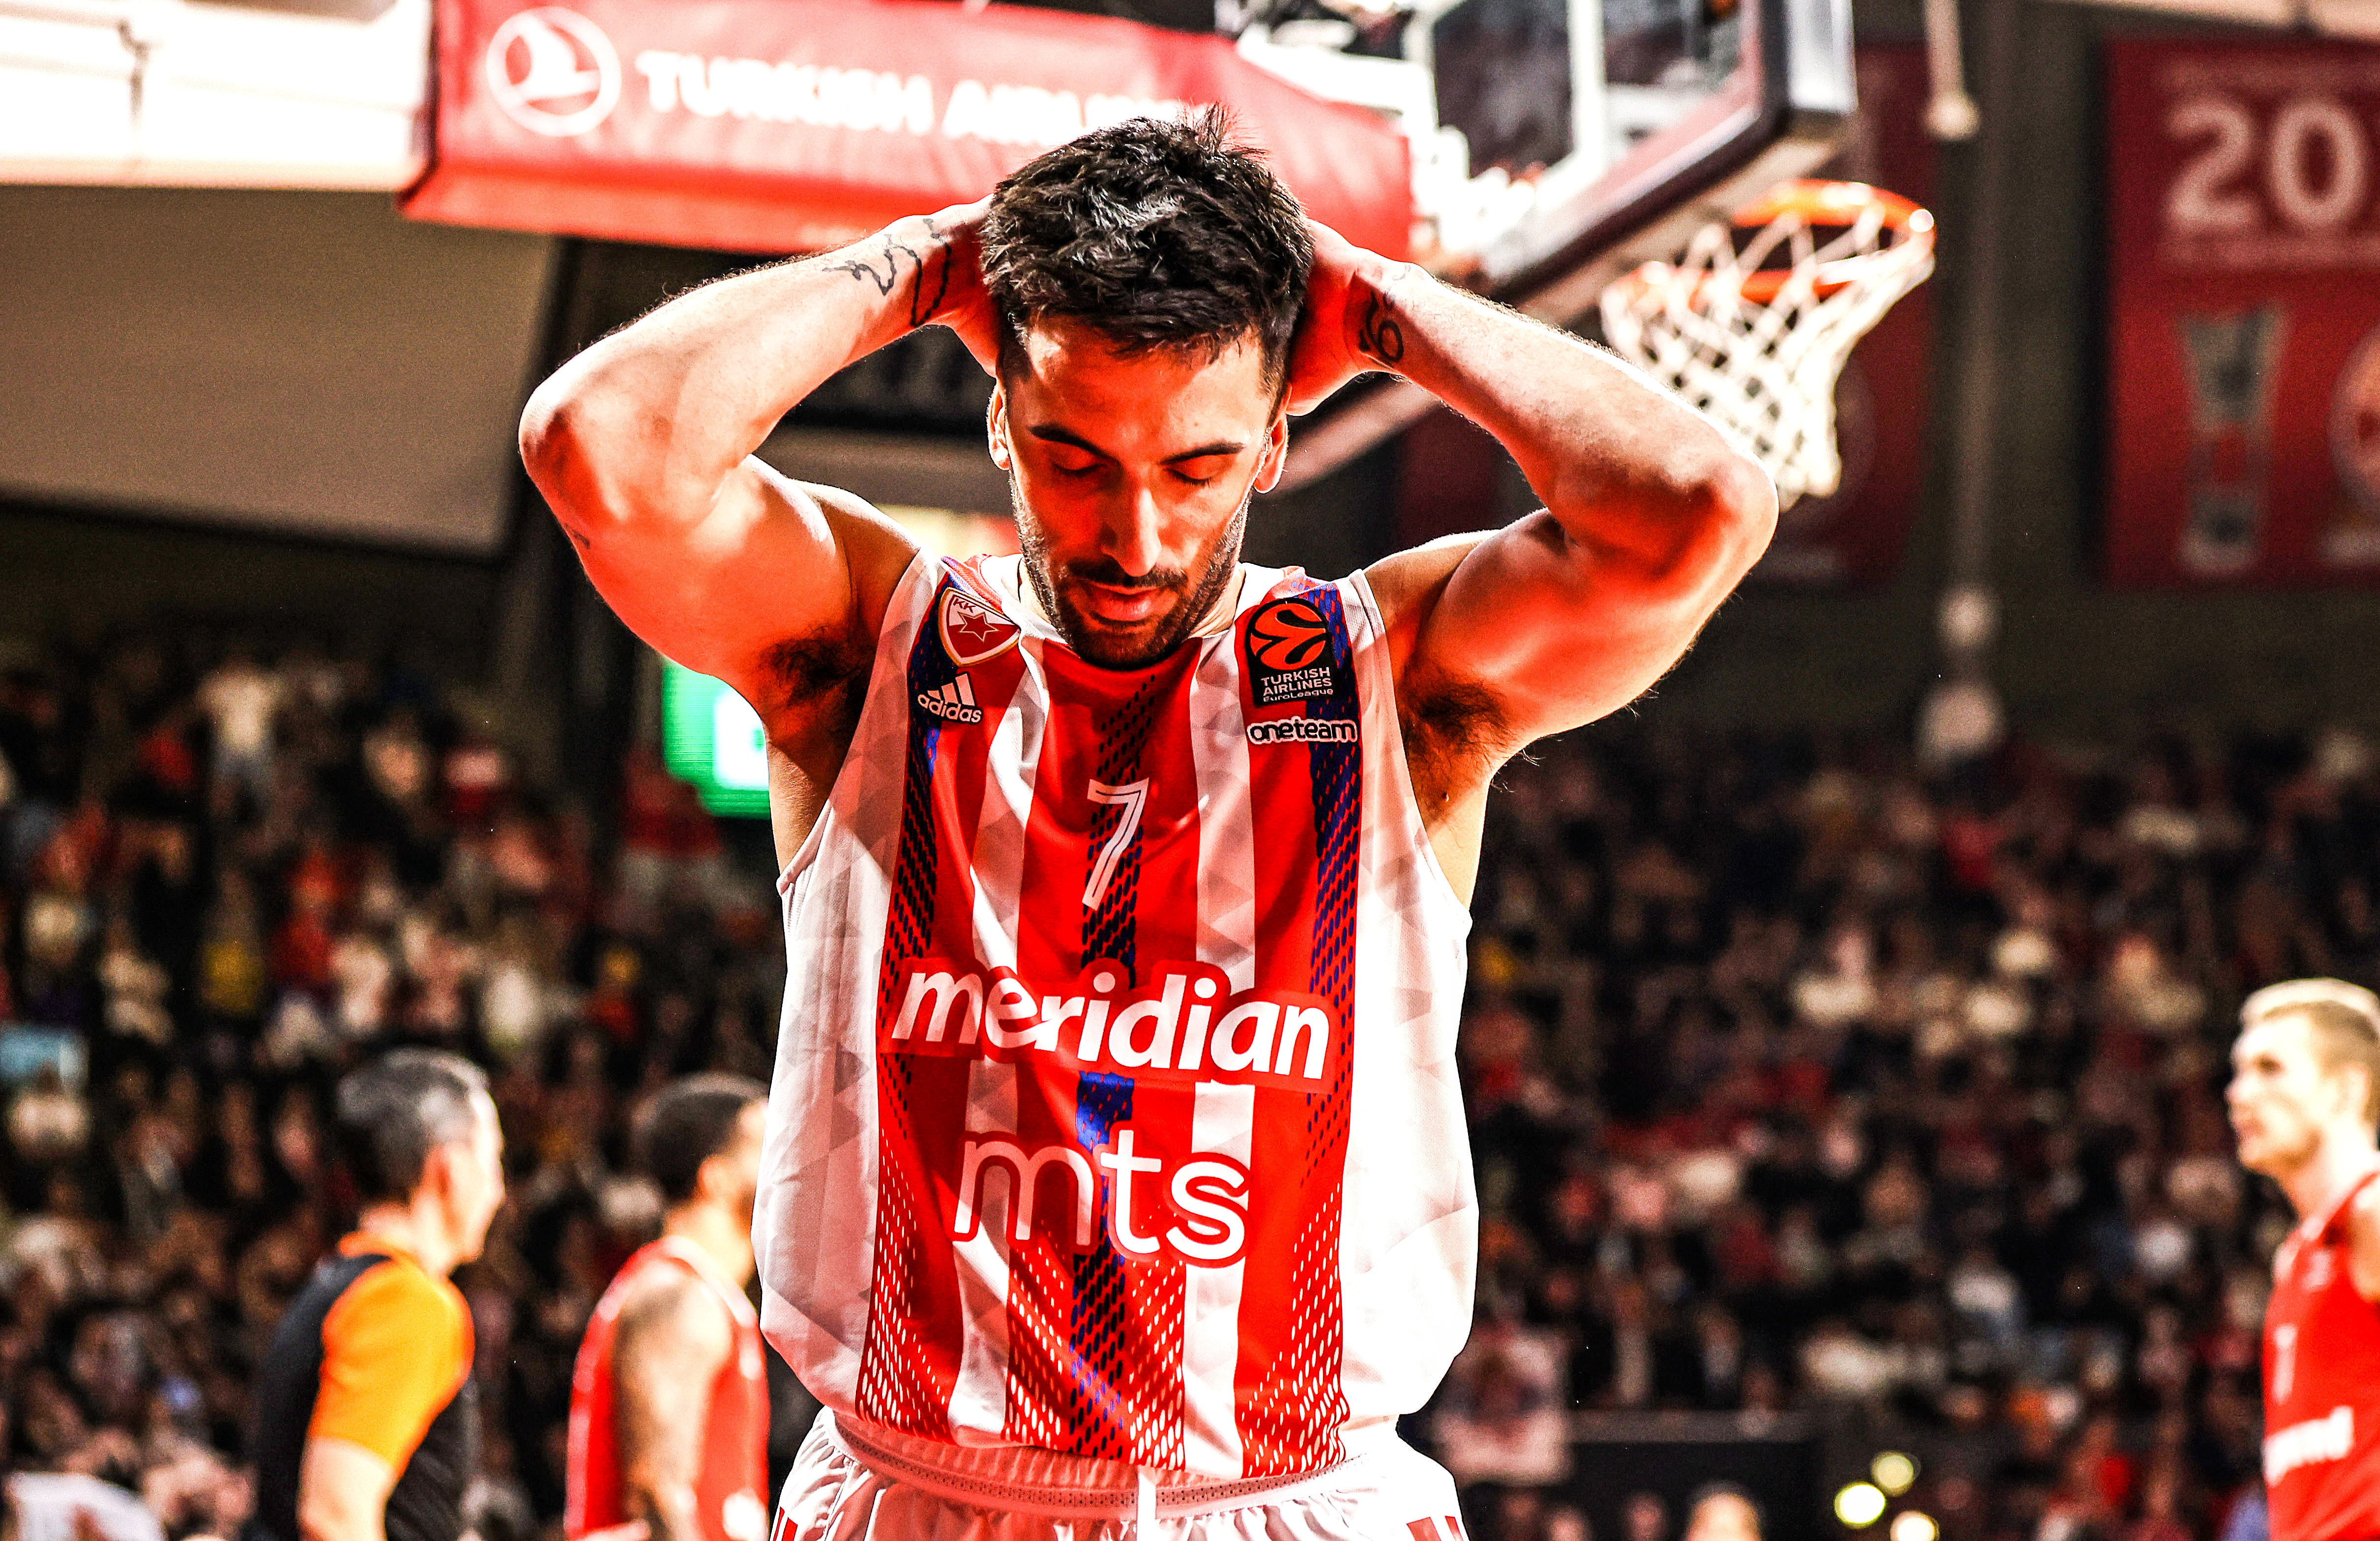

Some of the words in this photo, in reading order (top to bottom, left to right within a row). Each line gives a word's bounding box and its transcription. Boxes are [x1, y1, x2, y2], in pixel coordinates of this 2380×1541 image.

[953, 598, 976, 613] KK
[1261, 667, 1330, 686] TURKISH
[1263, 677, 1332, 697] AIRLINES
[917, 694, 982, 723] adidas
[1249, 717, 1356, 742] oneteam
[1082, 778, 1149, 910] 7
[891, 971, 1330, 1080] meridian
[953, 1129, 1247, 1260] mts
